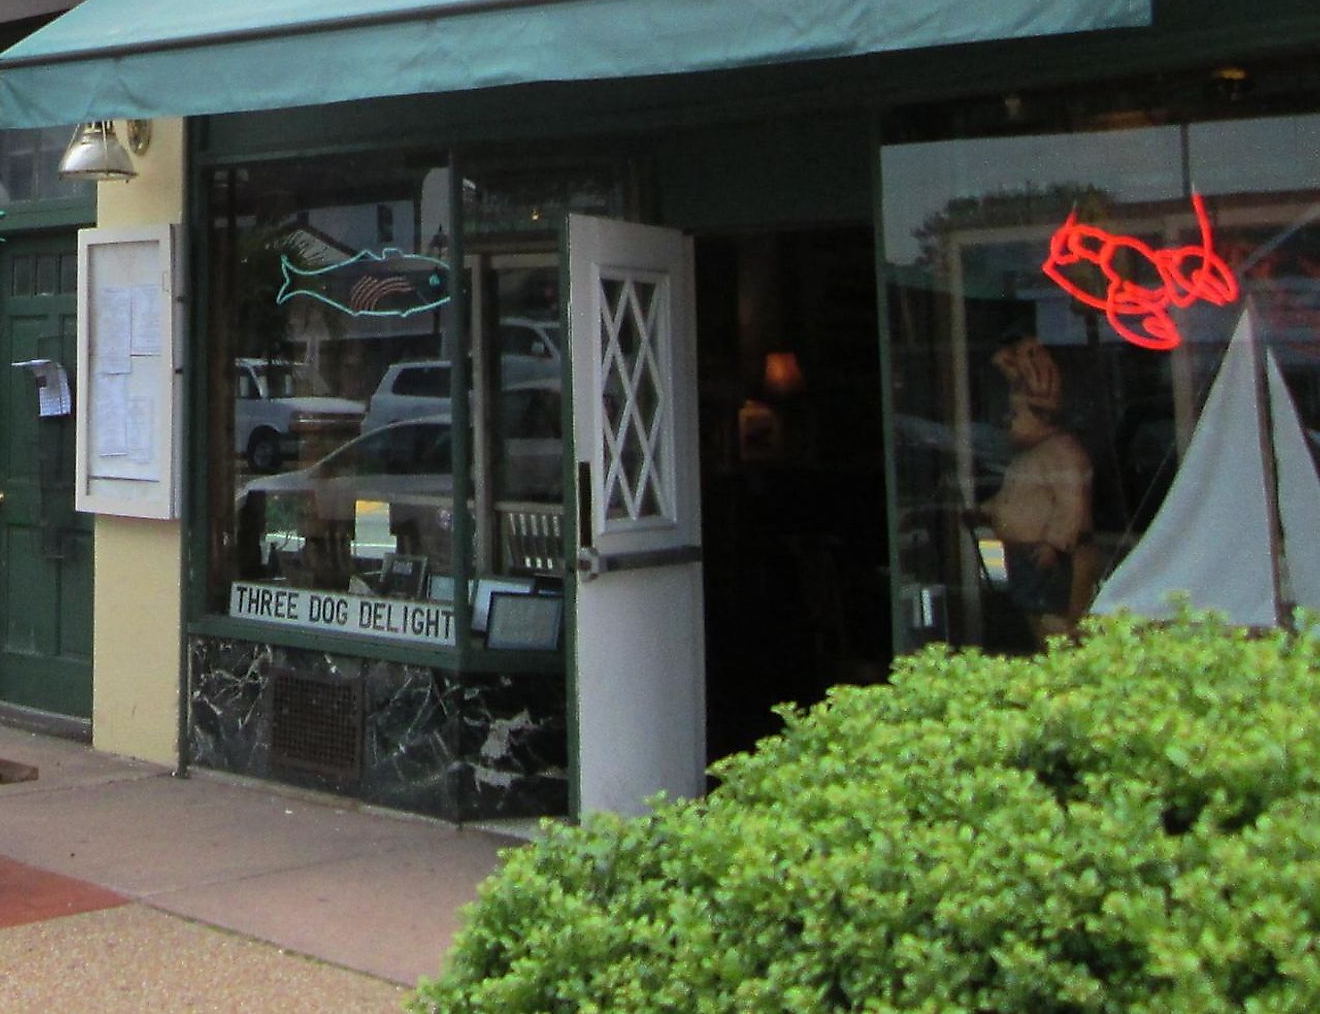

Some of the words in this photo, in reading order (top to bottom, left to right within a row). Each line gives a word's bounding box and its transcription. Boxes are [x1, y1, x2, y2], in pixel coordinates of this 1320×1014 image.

[236, 585, 299, 620] THREE
[309, 593, 349, 625] DOG
[358, 601, 455, 640] DELIGHT
